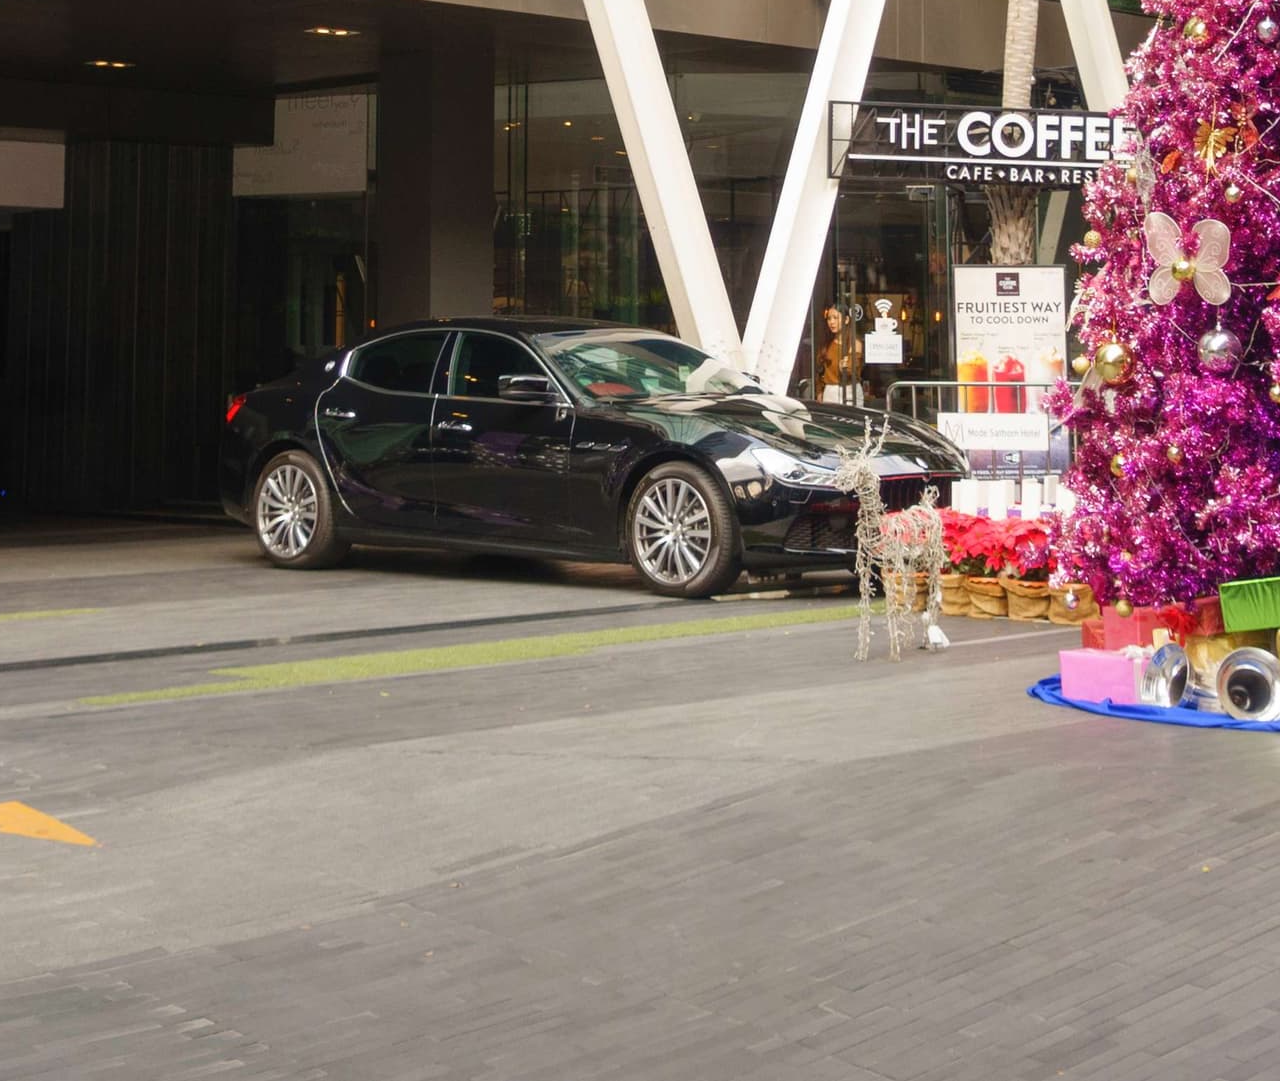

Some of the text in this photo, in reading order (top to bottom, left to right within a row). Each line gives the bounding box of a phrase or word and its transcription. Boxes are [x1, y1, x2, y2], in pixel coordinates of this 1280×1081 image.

[876, 111, 1137, 161] THE COFFEE
[946, 165, 993, 181] CAFE
[1010, 168, 1045, 183] BAR
[957, 302, 1062, 314] FRUITIEST WAY
[970, 316, 1049, 325] TO COOL DOWN
